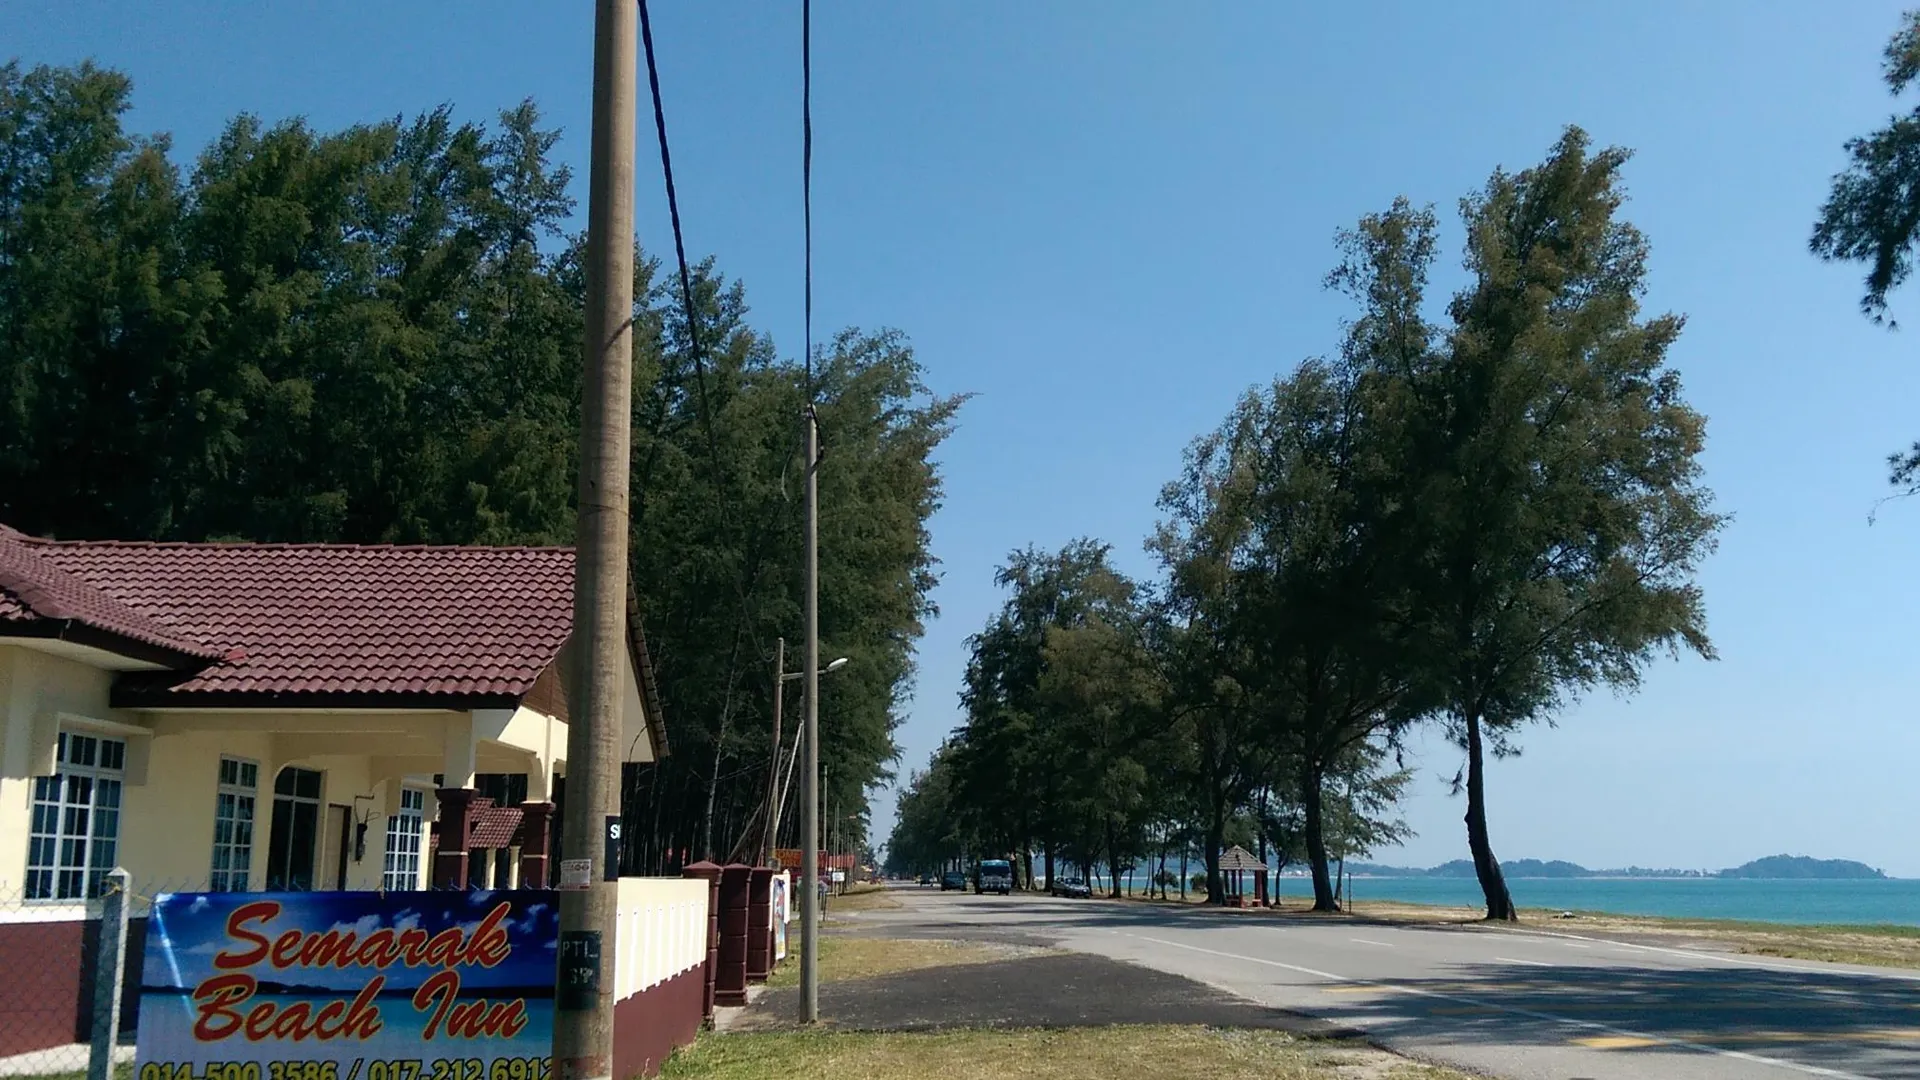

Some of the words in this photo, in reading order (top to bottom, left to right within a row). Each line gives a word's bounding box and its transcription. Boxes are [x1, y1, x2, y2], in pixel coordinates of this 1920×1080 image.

[214, 900, 512, 970] Semarak
[193, 974, 382, 1042] Beach
[414, 969, 528, 1041] Inn
